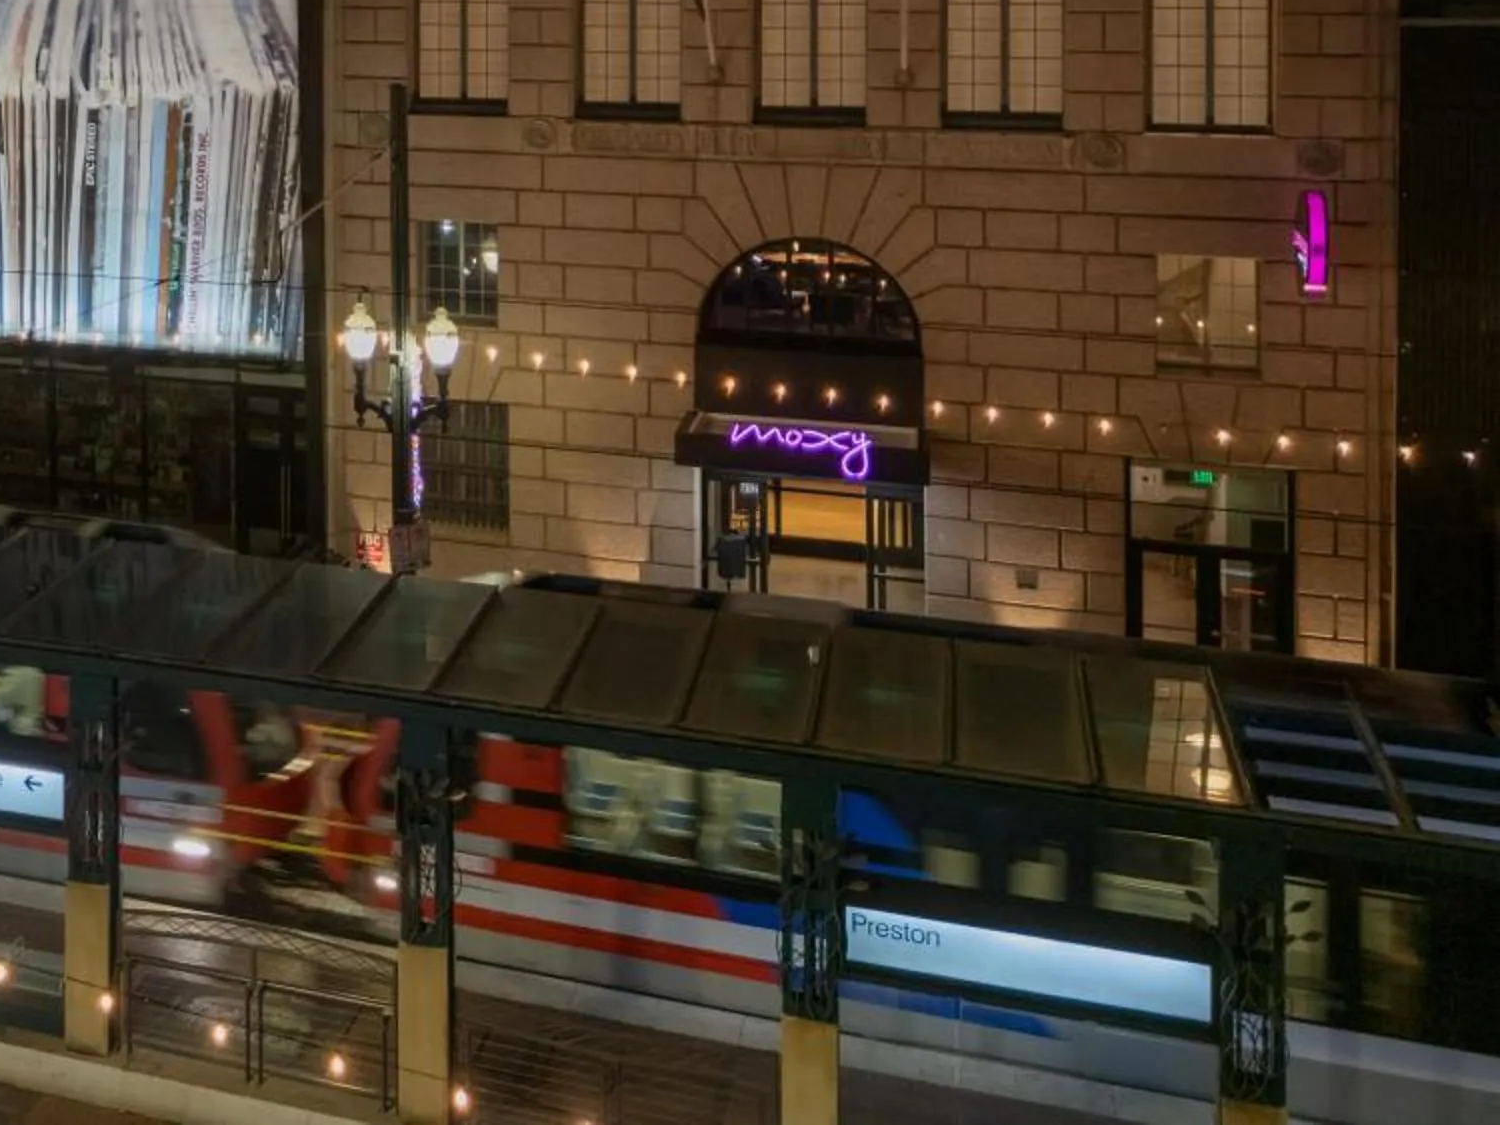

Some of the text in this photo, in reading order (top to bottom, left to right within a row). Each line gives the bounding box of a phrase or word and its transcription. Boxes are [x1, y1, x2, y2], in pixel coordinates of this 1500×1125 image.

[193, 154, 207, 202] RECORDS
[730, 422, 873, 479] moxy
[851, 912, 941, 948] Preston
